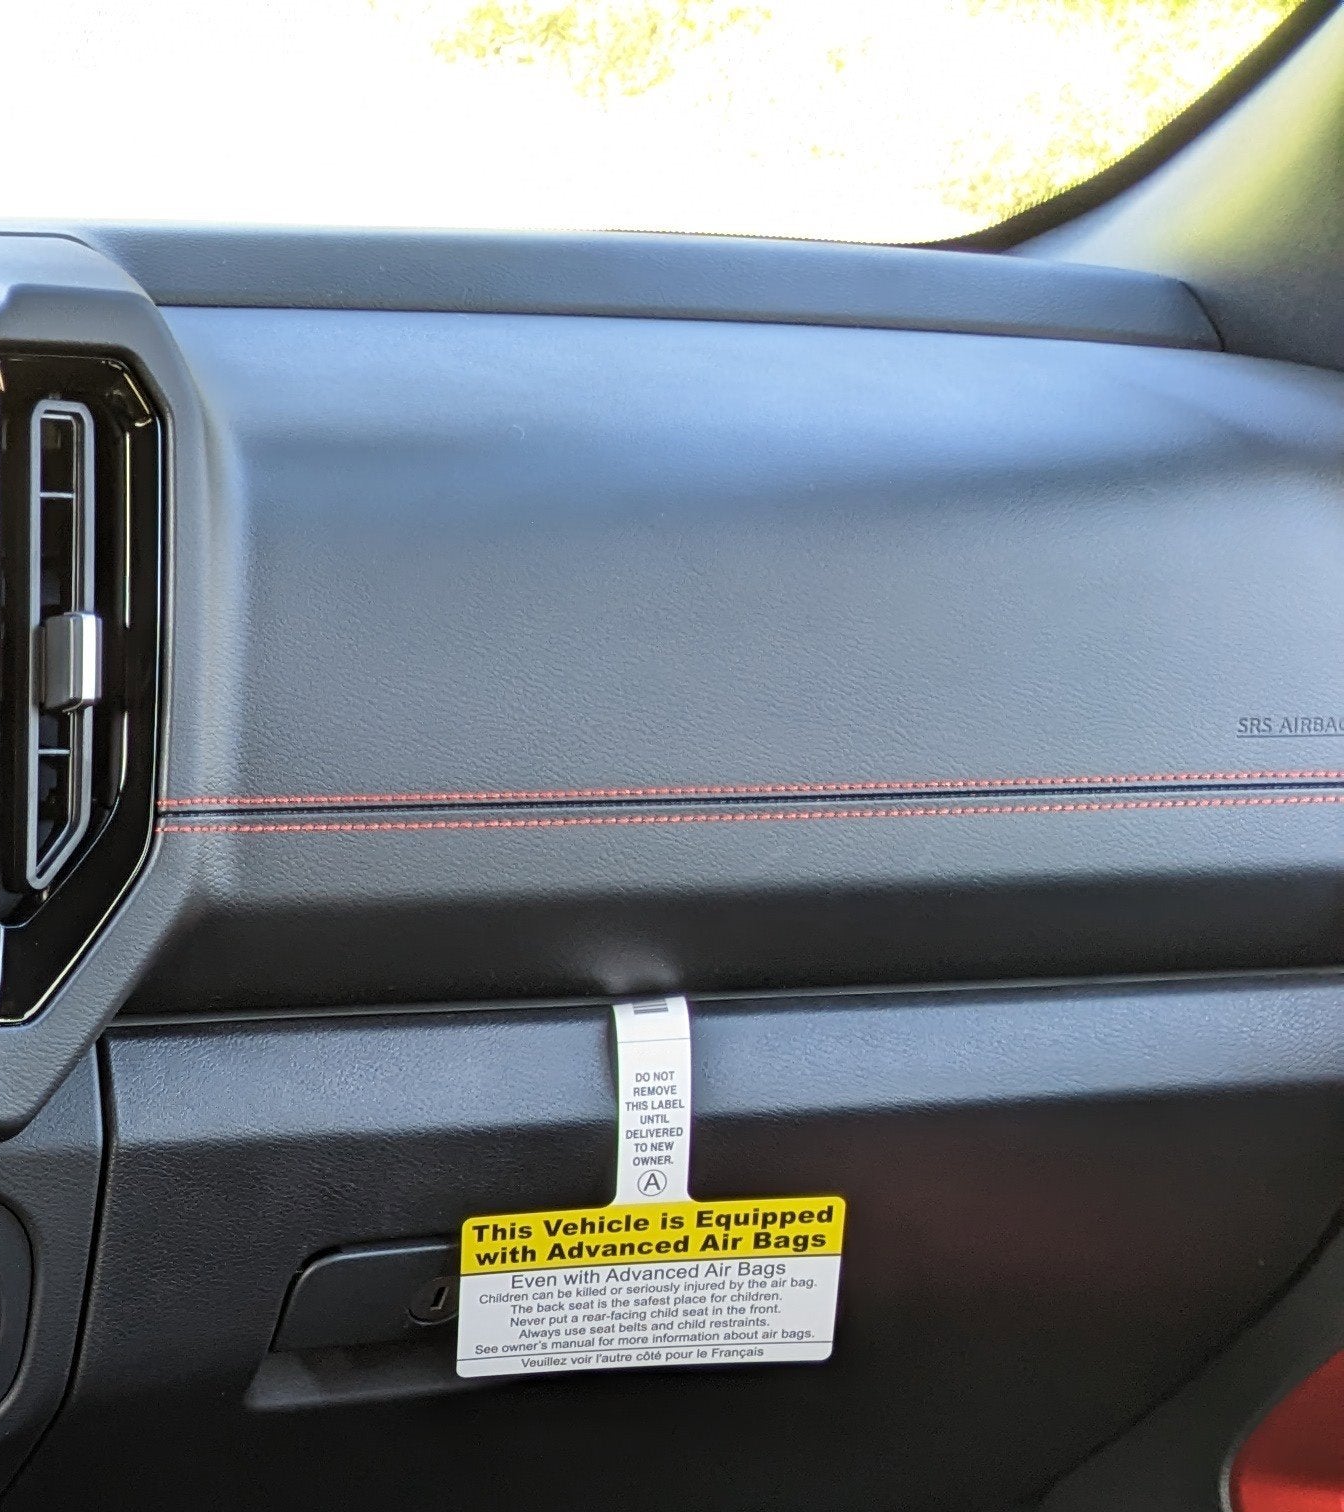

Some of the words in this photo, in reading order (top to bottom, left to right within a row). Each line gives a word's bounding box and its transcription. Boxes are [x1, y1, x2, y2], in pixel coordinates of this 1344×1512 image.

[1237, 717, 1272, 733] SRS
[635, 1073, 649, 1082] DO
[654, 1071, 675, 1081] NOT
[633, 1085, 677, 1097] REMOVE
[625, 1101, 648, 1111] THIS
[651, 1099, 685, 1109] LABEL
[640, 1114, 669, 1124] UNTIL
[625, 1127, 683, 1139] DELIVERED
[634, 1143, 647, 1152] TO
[651, 1141, 674, 1151] NEW
[472, 1223, 532, 1242] This
[543, 1215, 649, 1237] Vehicle
[661, 1213, 684, 1230] is
[696, 1205, 833, 1231] Equipped
[475, 1245, 536, 1266] with
[547, 1235, 689, 1261] Advanced
[699, 1234, 743, 1251] Air
[753, 1232, 826, 1252] Bags
[511, 1275, 556, 1289] Even
[564, 1270, 600, 1285] with
[606, 1264, 699, 1283] Advanced
[704, 1262, 731, 1278] Air
[738, 1262, 786, 1278] Bags
[479, 1293, 528, 1304] Children
[532, 1292, 553, 1300] can
[558, 1289, 572, 1298] be
[576, 1285, 606, 1297] killed
[626, 1282, 679, 1294] seriously
[684, 1279, 725, 1291] injured
[729, 1279, 744, 1291] by
[748, 1279, 767, 1288] the
[771, 1278, 787, 1287] air
[511, 1305, 532, 1314] The
[537, 1302, 564, 1313] back
[568, 1301, 594, 1310] seat
[598, 1300, 607, 1308] is
[611, 1298, 630, 1308] the
[633, 1295, 670, 1306] safest
[674, 1294, 706, 1306] place
[711, 1293, 727, 1303] for
[730, 1292, 782, 1302] children.
[519, 1328, 560, 1339] Always
[565, 1327, 586, 1336] use
[590, 1325, 615, 1334] seat
[618, 1322, 647, 1332] belts
[651, 1321, 673, 1331] and
[678, 1320, 705, 1329] child
[710, 1318, 769, 1328] restraints.
[521, 1357, 567, 1367] Veuillez
[571, 1355, 592, 1365] voir
[636, 1351, 661, 1361] côté
[665, 1352, 693, 1362] pour
[697, 1351, 707, 1359] le
[712, 1347, 764, 1359] Français
